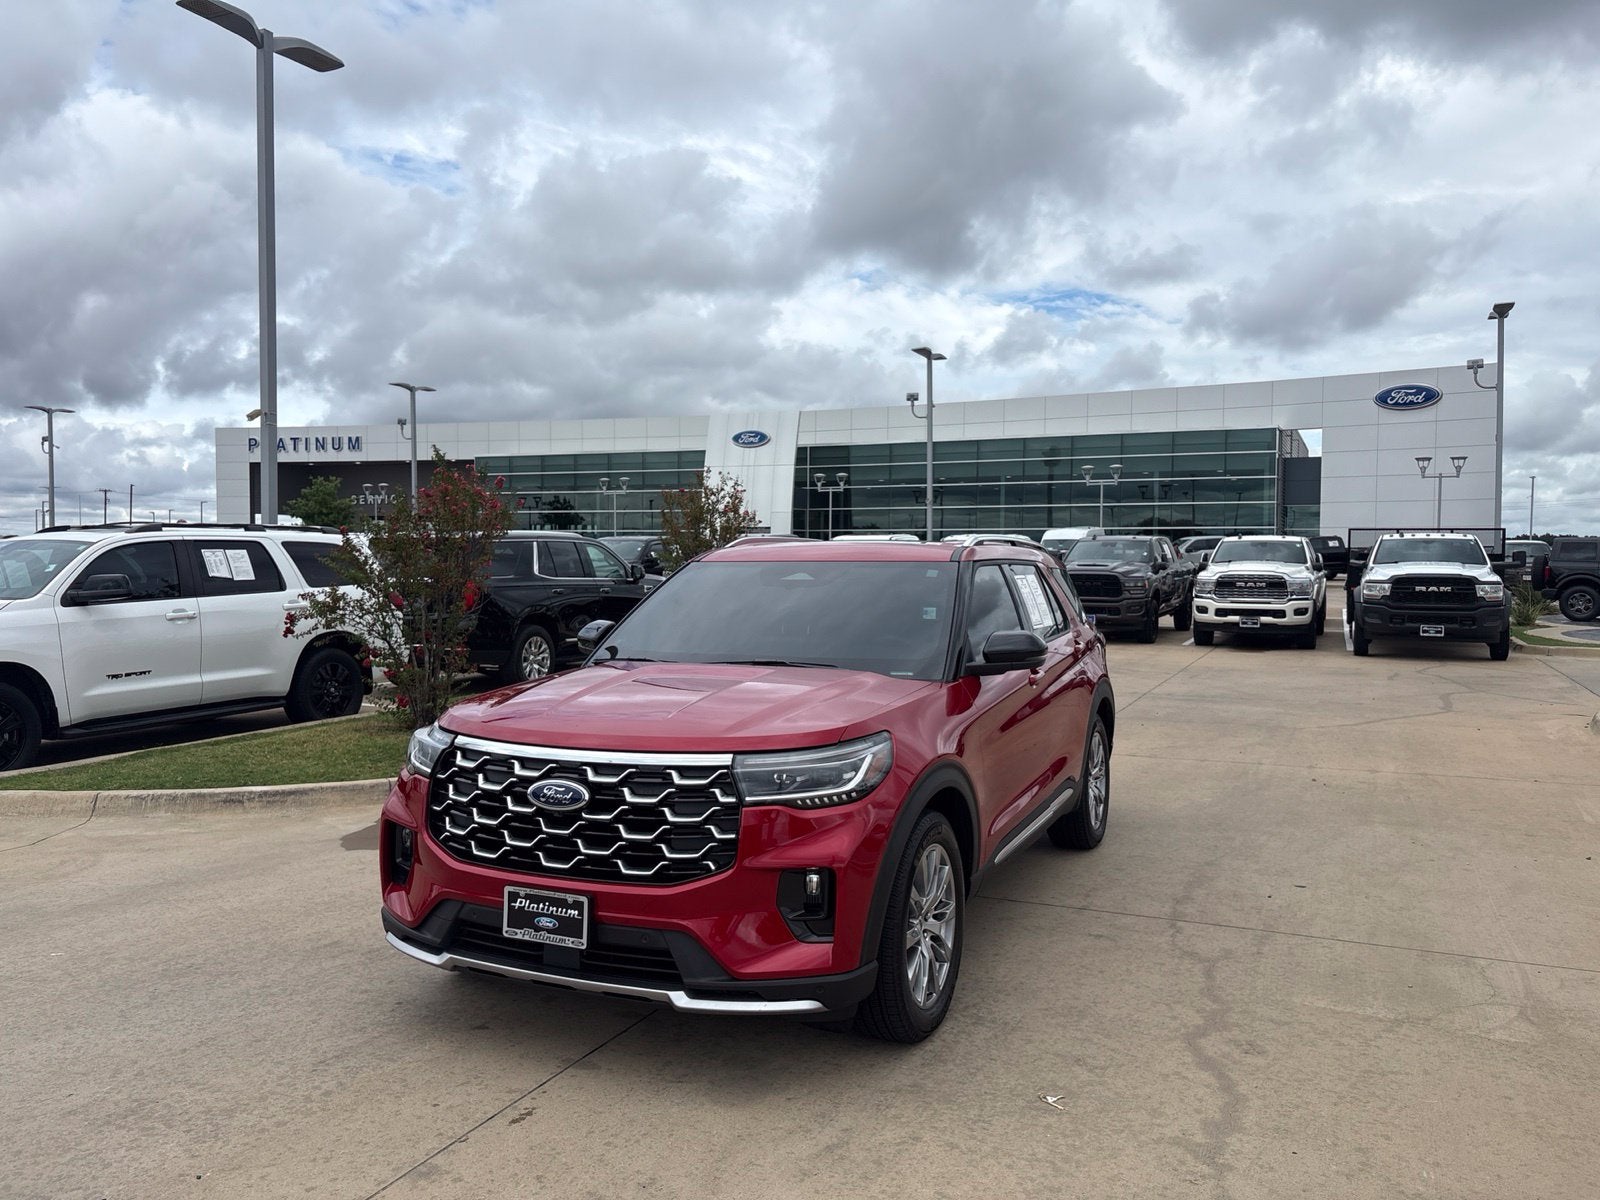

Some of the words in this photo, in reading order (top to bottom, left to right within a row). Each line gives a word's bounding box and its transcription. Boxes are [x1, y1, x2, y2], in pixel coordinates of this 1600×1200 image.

[1387, 388, 1427, 404] Ford
[248, 436, 362, 453] PATINUM
[738, 433, 760, 443] Ford
[124, 670, 152, 678] SPORT
[540, 786, 574, 803] Ford
[510, 898, 582, 918] Platinum
[522, 929, 570, 945] Platinum
